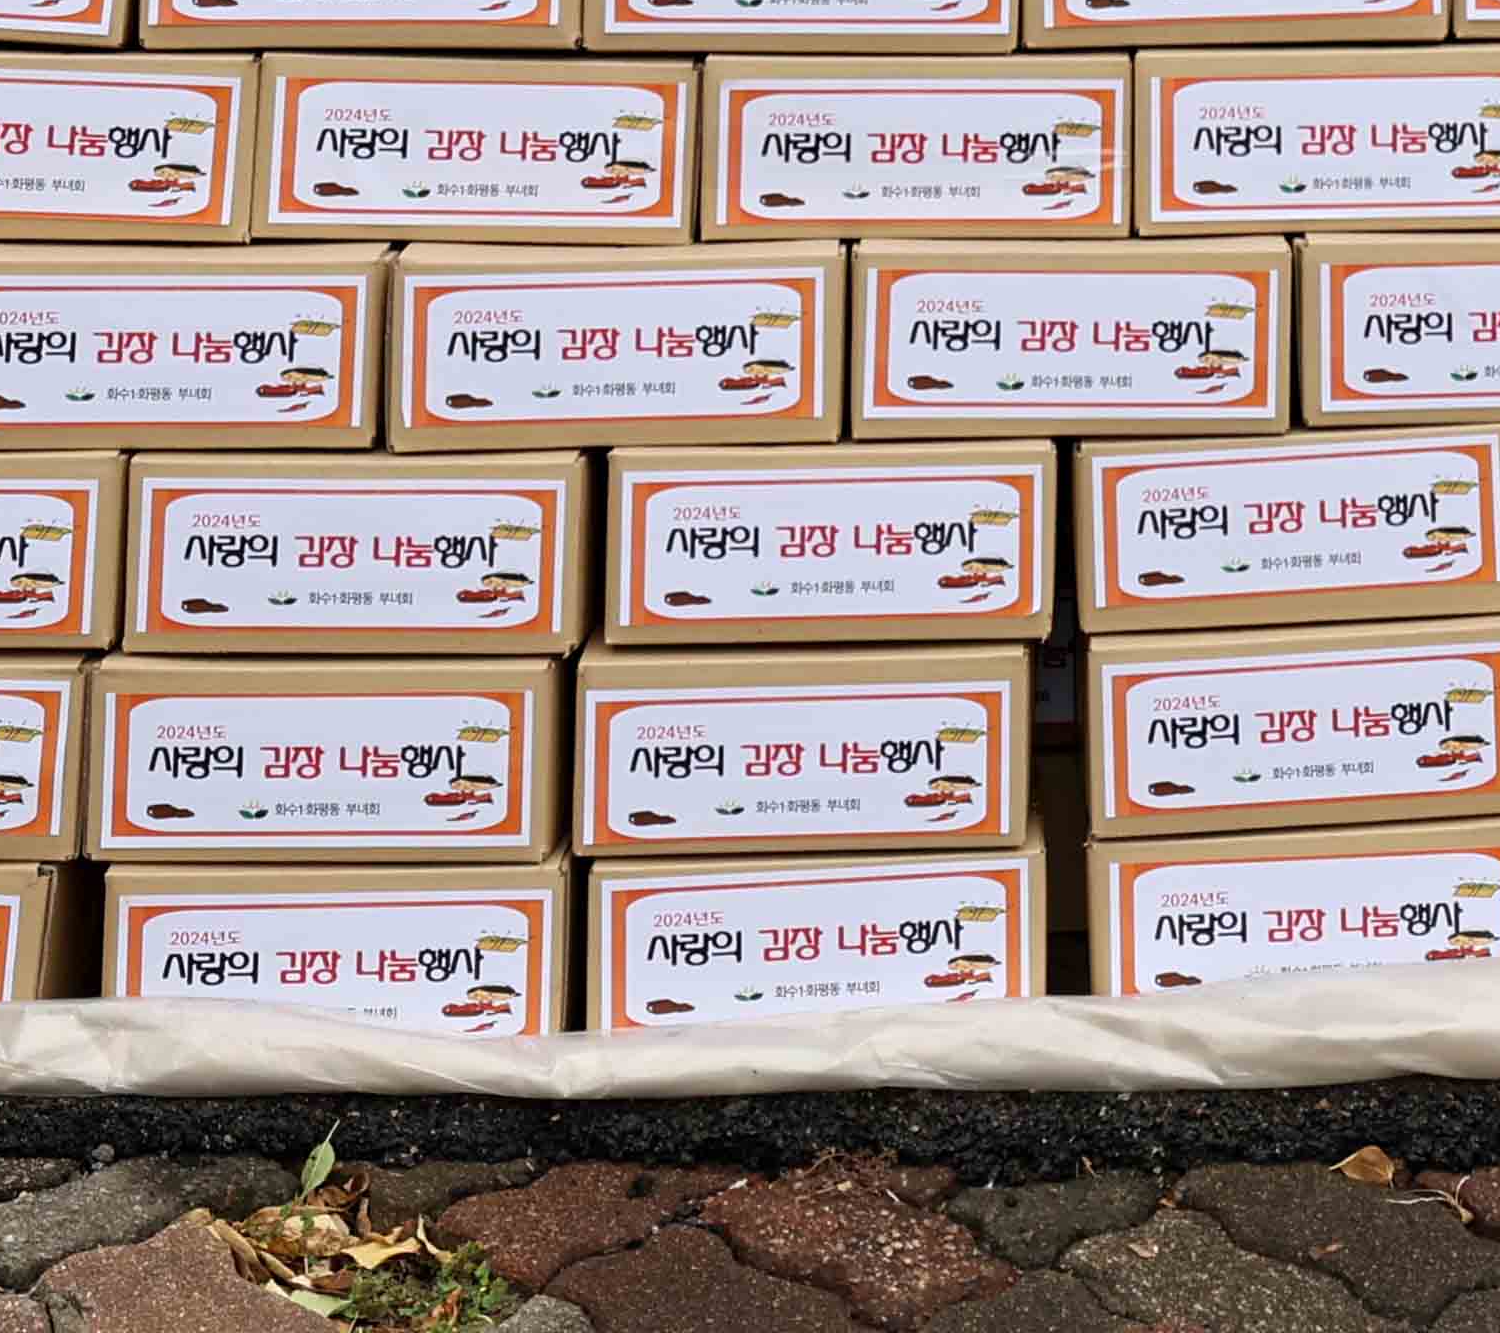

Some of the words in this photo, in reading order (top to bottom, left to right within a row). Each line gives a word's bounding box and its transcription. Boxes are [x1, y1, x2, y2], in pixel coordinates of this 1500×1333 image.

[323, 106, 395, 123] 2024년도
[315, 126, 409, 159] 사랑의
[425, 130, 486, 161] 김장
[1368, 290, 1438, 309] 2024년도
[1361, 311, 1454, 345] 사랑의
[1141, 483, 1213, 505] 2024년도
[1135, 503, 1230, 542] 사랑의
[1244, 500, 1306, 535] 김장
[155, 723, 229, 741] 2024년도
[147, 745, 244, 779] 사랑의
[261, 746, 325, 779] 김장
